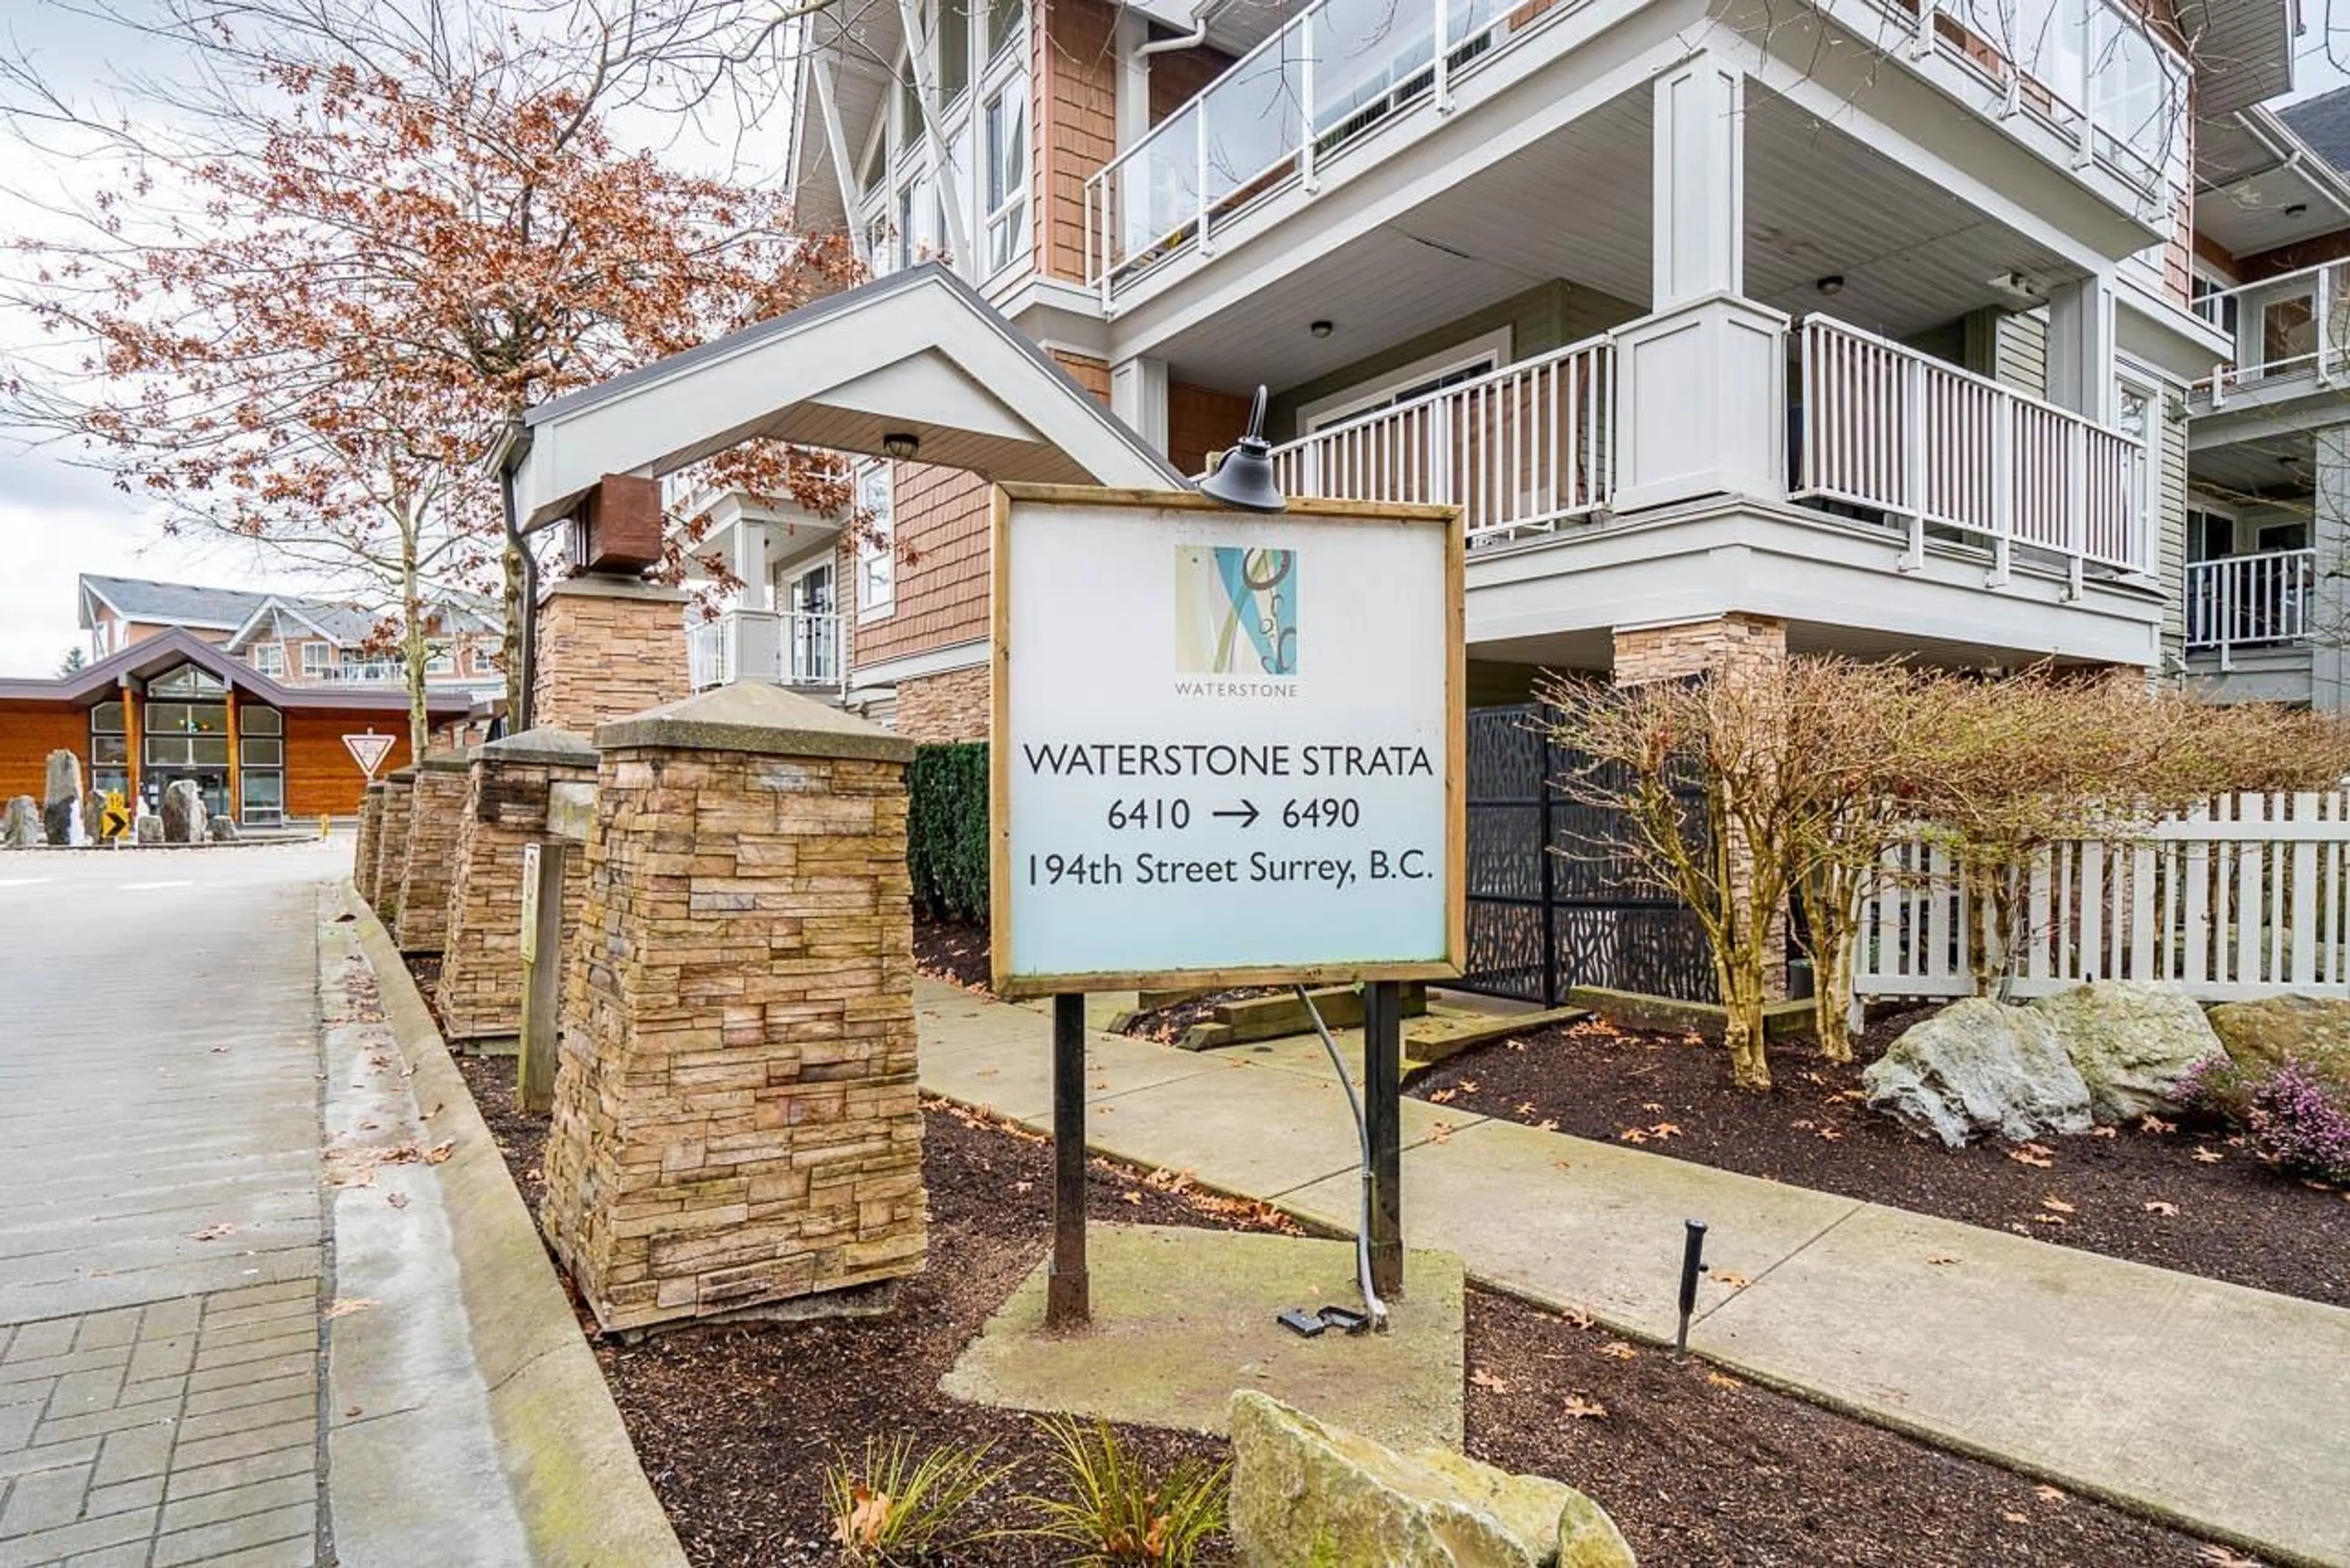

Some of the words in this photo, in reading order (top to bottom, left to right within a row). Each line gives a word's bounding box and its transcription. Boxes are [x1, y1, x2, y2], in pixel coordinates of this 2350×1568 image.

[1174, 682, 1297, 698] WATERSTONE
[1023, 743, 1290, 777] WATERSTONE
[1302, 745, 1434, 777] STRATA
[1107, 797, 1191, 830] 6410
[1282, 797, 1360, 829] 6490
[1029, 853, 1122, 886] 194th
[1136, 853, 1239, 885] Street
[1249, 851, 1357, 890] Surrey,
[1370, 849, 1434, 880] B.C.
